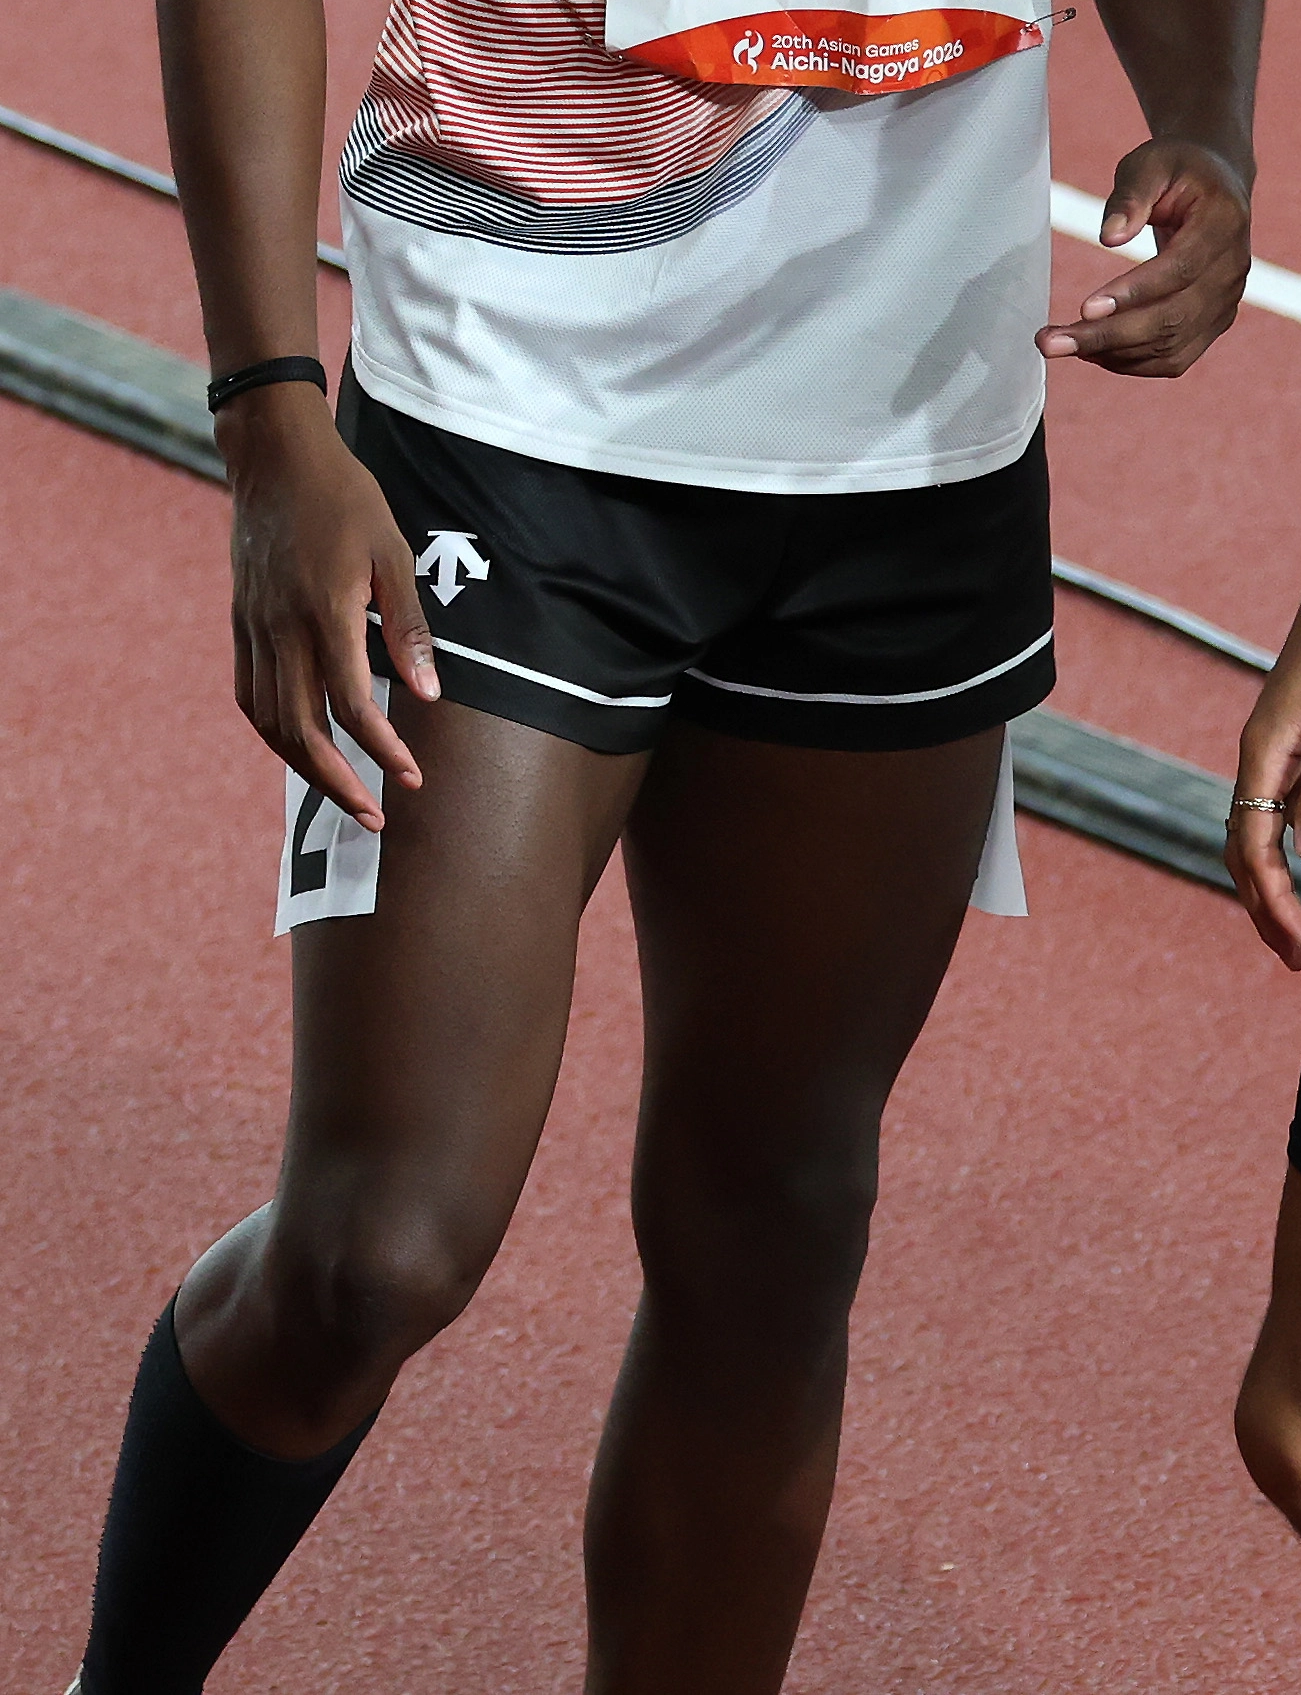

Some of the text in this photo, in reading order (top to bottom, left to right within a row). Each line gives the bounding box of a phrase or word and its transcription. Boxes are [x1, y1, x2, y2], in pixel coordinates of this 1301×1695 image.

[770, 40, 965, 84] Aichi-Nagoya 2026
[771, 34, 920, 58] 20th Asian Games
